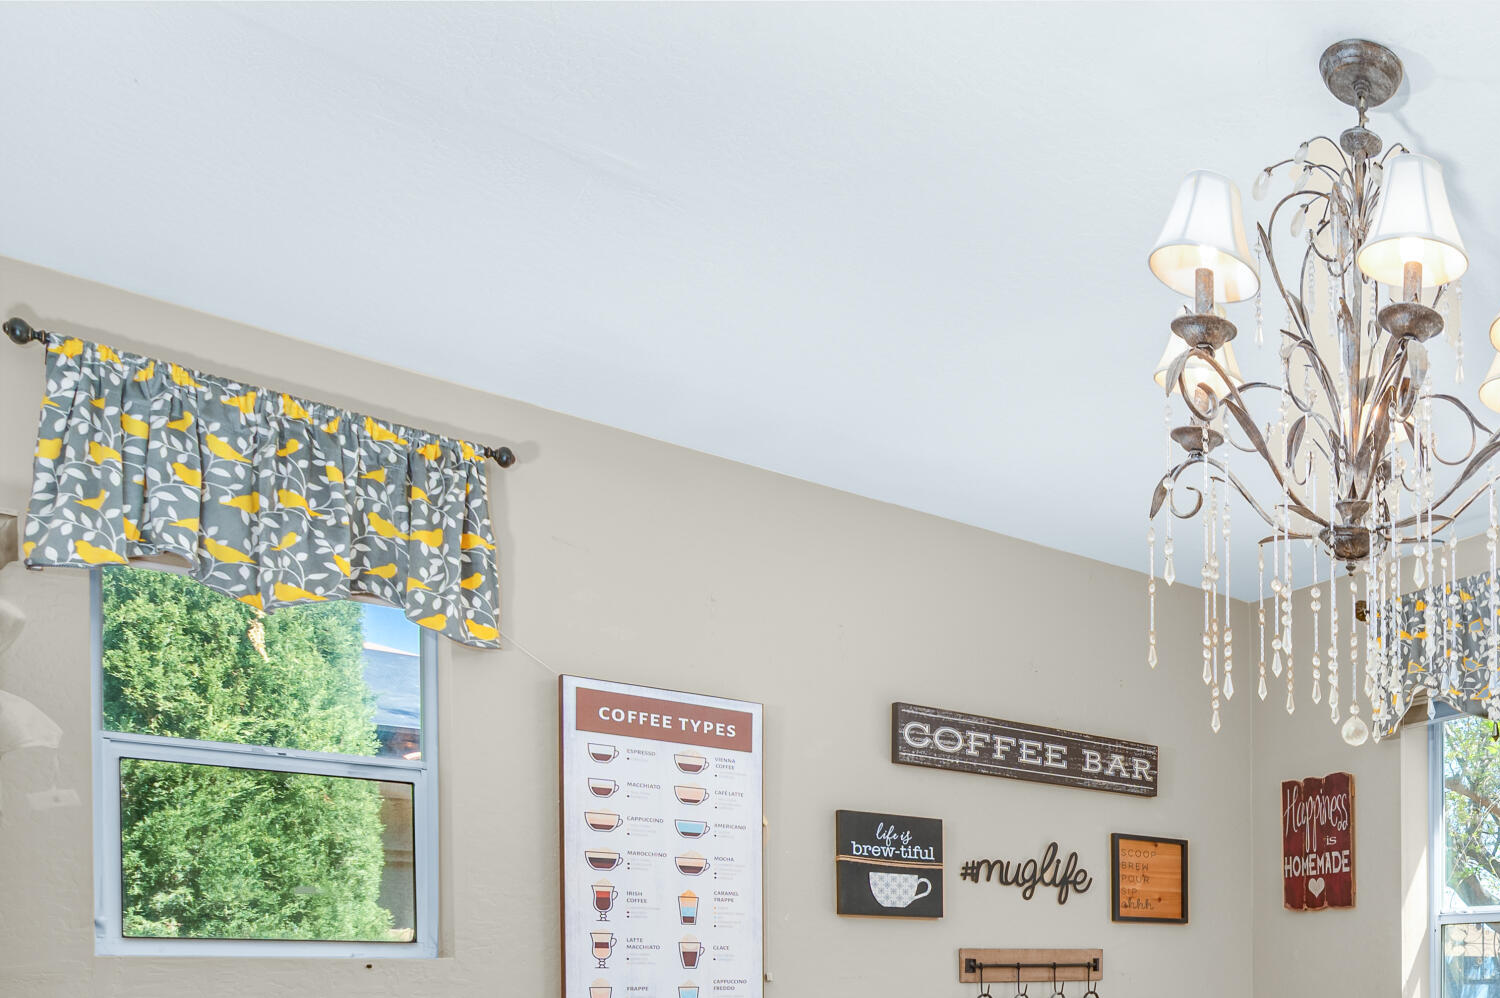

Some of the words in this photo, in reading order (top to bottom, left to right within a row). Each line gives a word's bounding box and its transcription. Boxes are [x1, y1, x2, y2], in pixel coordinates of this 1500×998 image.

[598, 706, 672, 729] COFFEE
[678, 716, 737, 738] TYPES
[626, 749, 656, 757] ESPRESSO
[902, 721, 1068, 769] COFFEE
[1081, 748, 1154, 783] BAR
[626, 782, 661, 790] MACCHIATO
[626, 815, 664, 824] CAPPUCCINO
[1284, 785, 1349, 853] Happiness
[875, 822, 899, 846] life
[900, 830, 913, 845] is
[1325, 835, 1337, 845] is
[851, 840, 936, 860] brew-tiful
[1121, 848, 1157, 859] SCOOP
[1121, 861, 1149, 871] BREW
[1284, 849, 1351, 879] HOMEMADE
[960, 842, 1093, 905] #muglife
[1121, 874, 1150, 884] POUR
[1121, 887, 1138, 896] SIP
